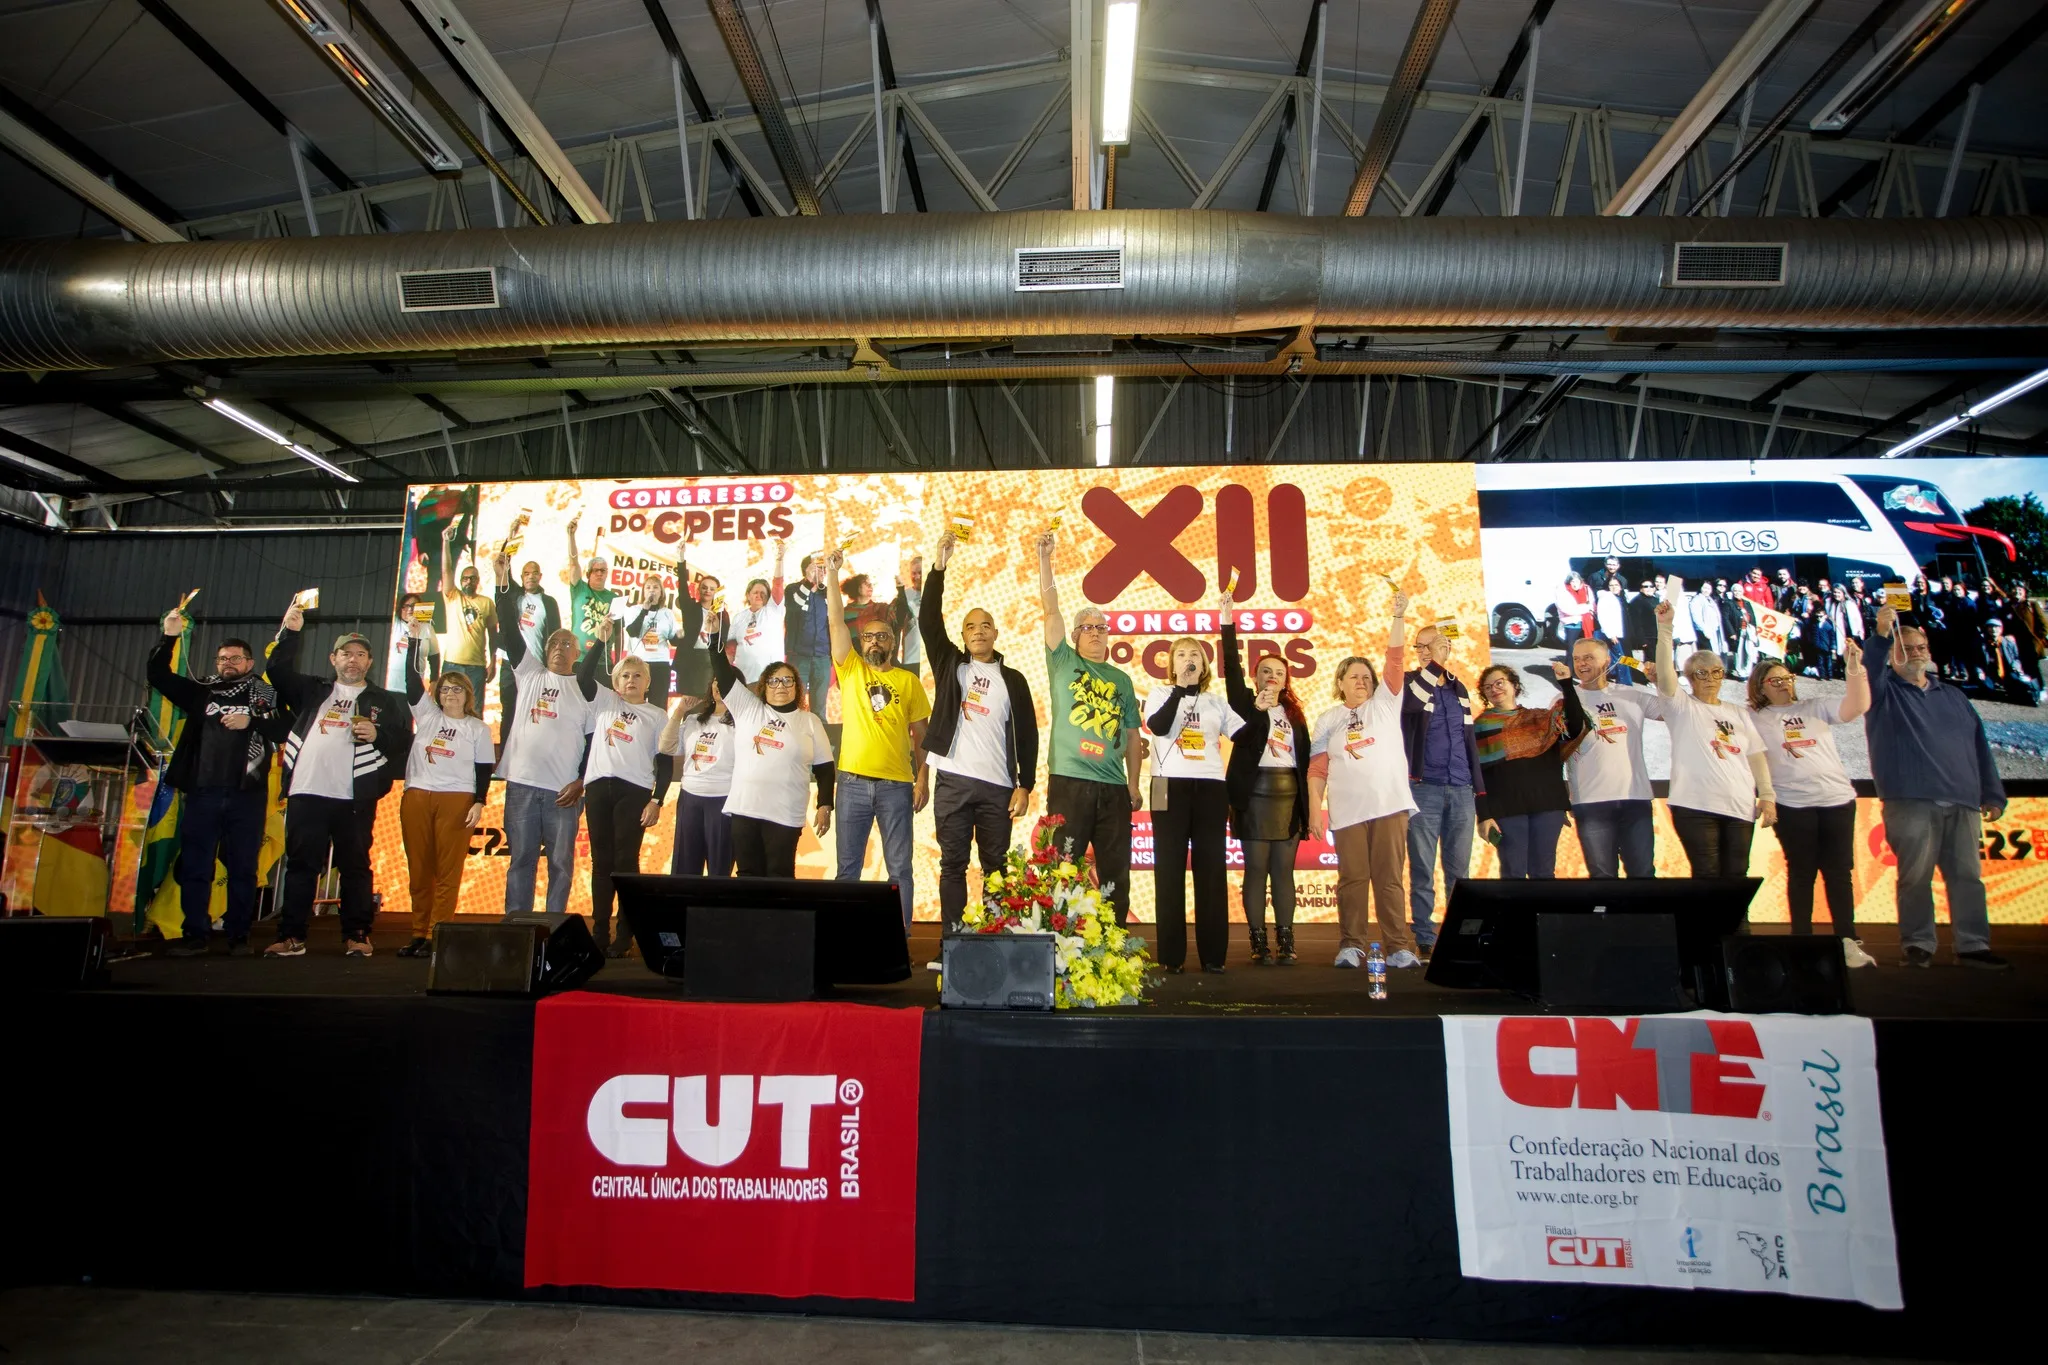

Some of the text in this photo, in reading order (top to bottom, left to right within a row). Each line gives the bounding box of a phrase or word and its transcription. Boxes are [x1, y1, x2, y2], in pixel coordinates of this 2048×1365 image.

[615, 484, 788, 508] CONGRESSO
[610, 506, 795, 544] DO CPERS
[1081, 483, 1310, 605] XII
[1590, 526, 1780, 554] LC Nunes
[613, 555, 635, 570] NA
[638, 558, 689, 581] DEFES
[1104, 640, 1134, 665] O
[542, 687, 560, 698] XII
[972, 675, 991, 689] XII
[332, 699, 353, 709] XII
[620, 711, 638, 721] XII
[1595, 702, 1615, 714] XII
[438, 726, 457, 738] XII
[768, 718, 787, 729] XII
[1782, 717, 1804, 727] XII
[699, 732, 718, 740] XII
[1081, 741, 1105, 755] CTB
[1496, 1017, 1767, 1119] CNTE
[587, 1074, 838, 1169] CUT
[1802, 1048, 1847, 1216] Brasil
[840, 1107, 860, 1199] BRASIL
[1508, 1134, 1781, 1167] Confederação Nacional dos
[592, 1172, 829, 1201] CENTRAL ÚNICA DOS TRABALHADORES
[1510, 1160, 1783, 1195] Trabalhadores em Educação
[1515, 1190, 1640, 1209] www.cnte.org.br
[1544, 1224, 1573, 1236] Filiada
[1548, 1238, 1623, 1266] CUT
[1625, 1238, 1634, 1269] BRASIL
